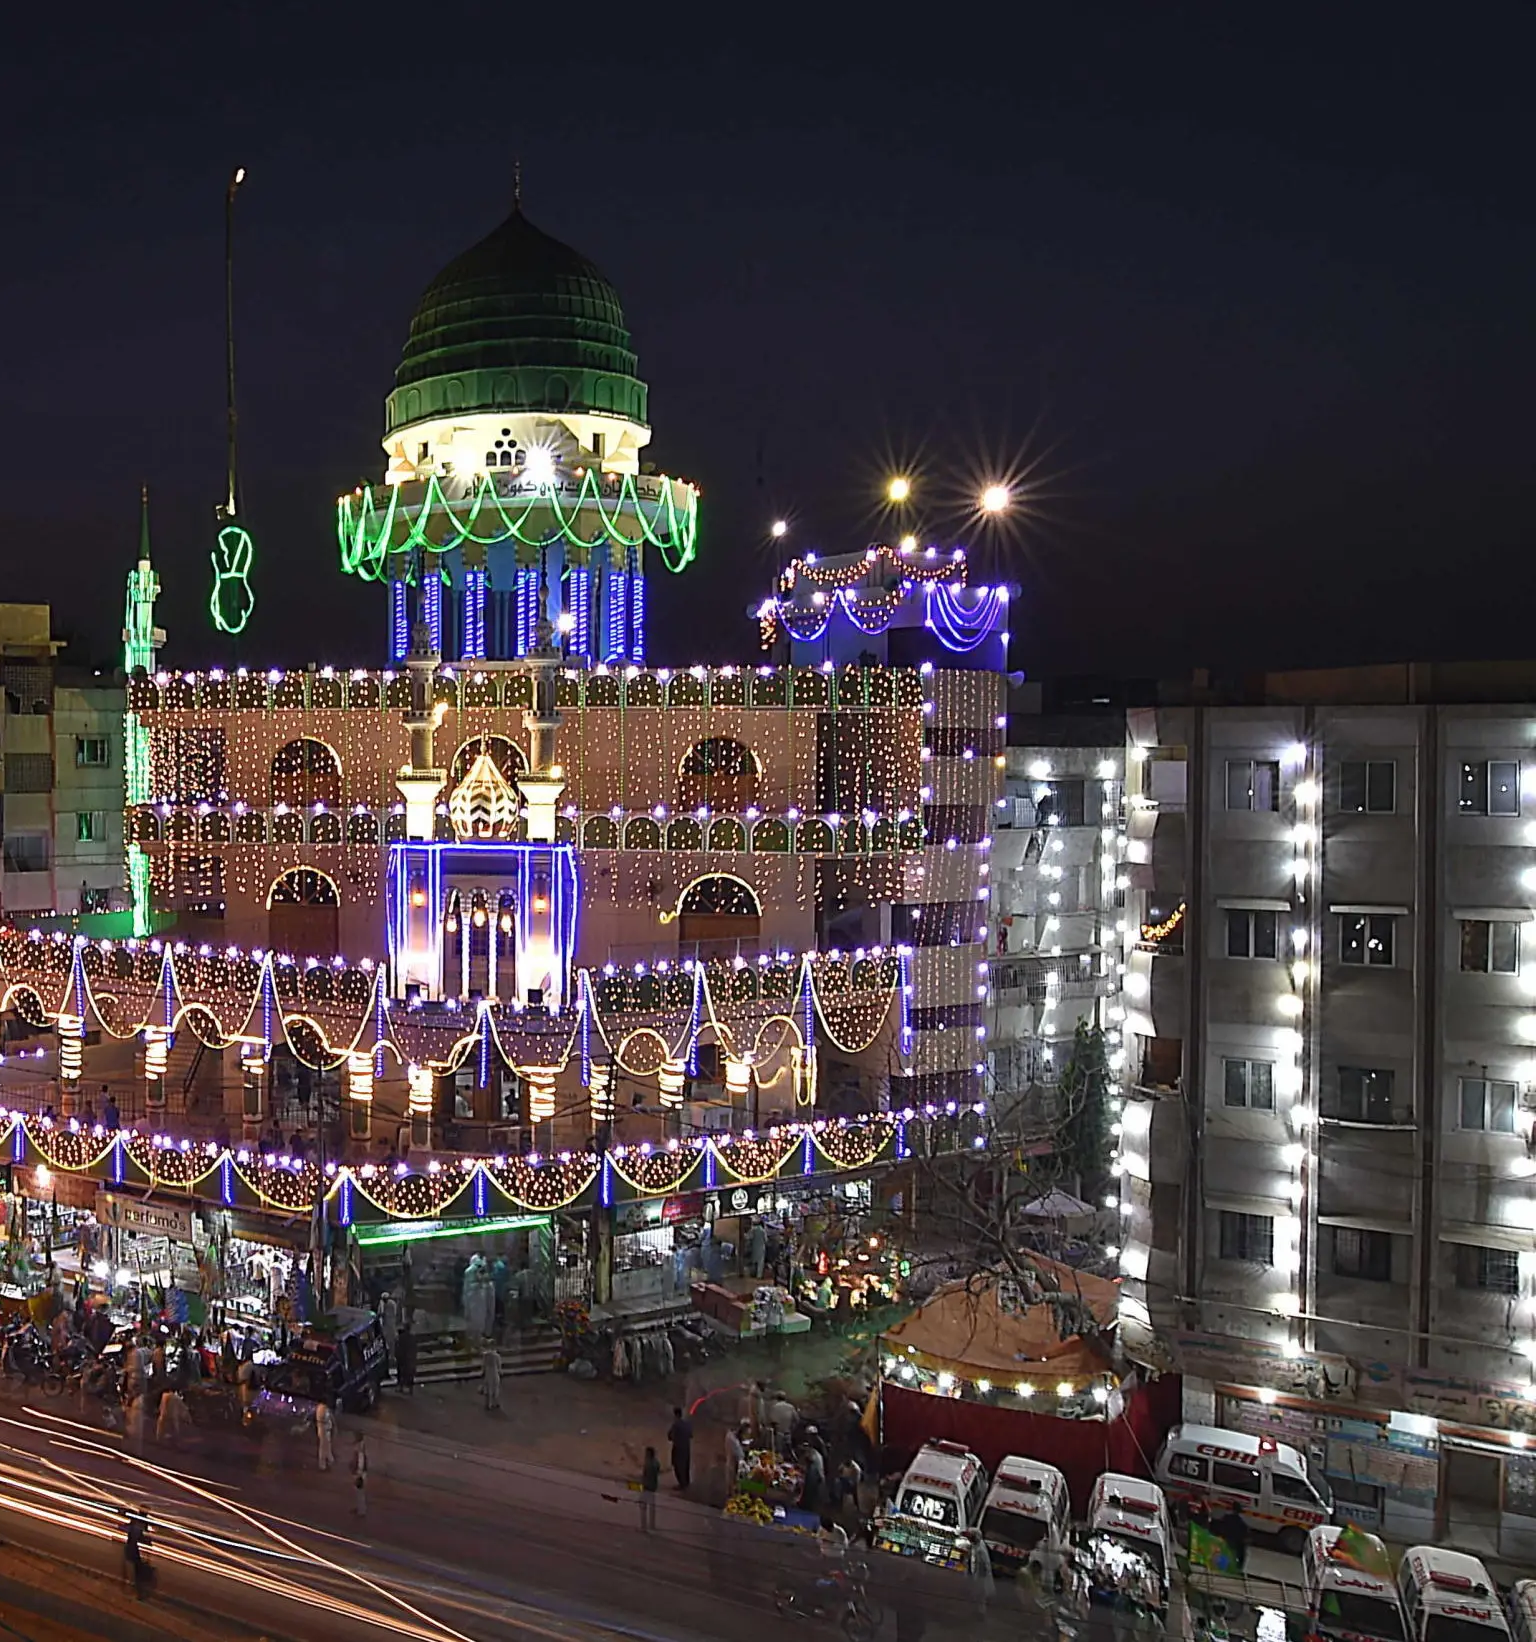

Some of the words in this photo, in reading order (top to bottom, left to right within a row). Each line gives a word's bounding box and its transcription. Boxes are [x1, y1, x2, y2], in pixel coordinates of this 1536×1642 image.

[1196, 1443, 1259, 1466] EDHI
[1283, 1507, 1325, 1524] EDHI
[1337, 1505, 1377, 1520] ENTER
